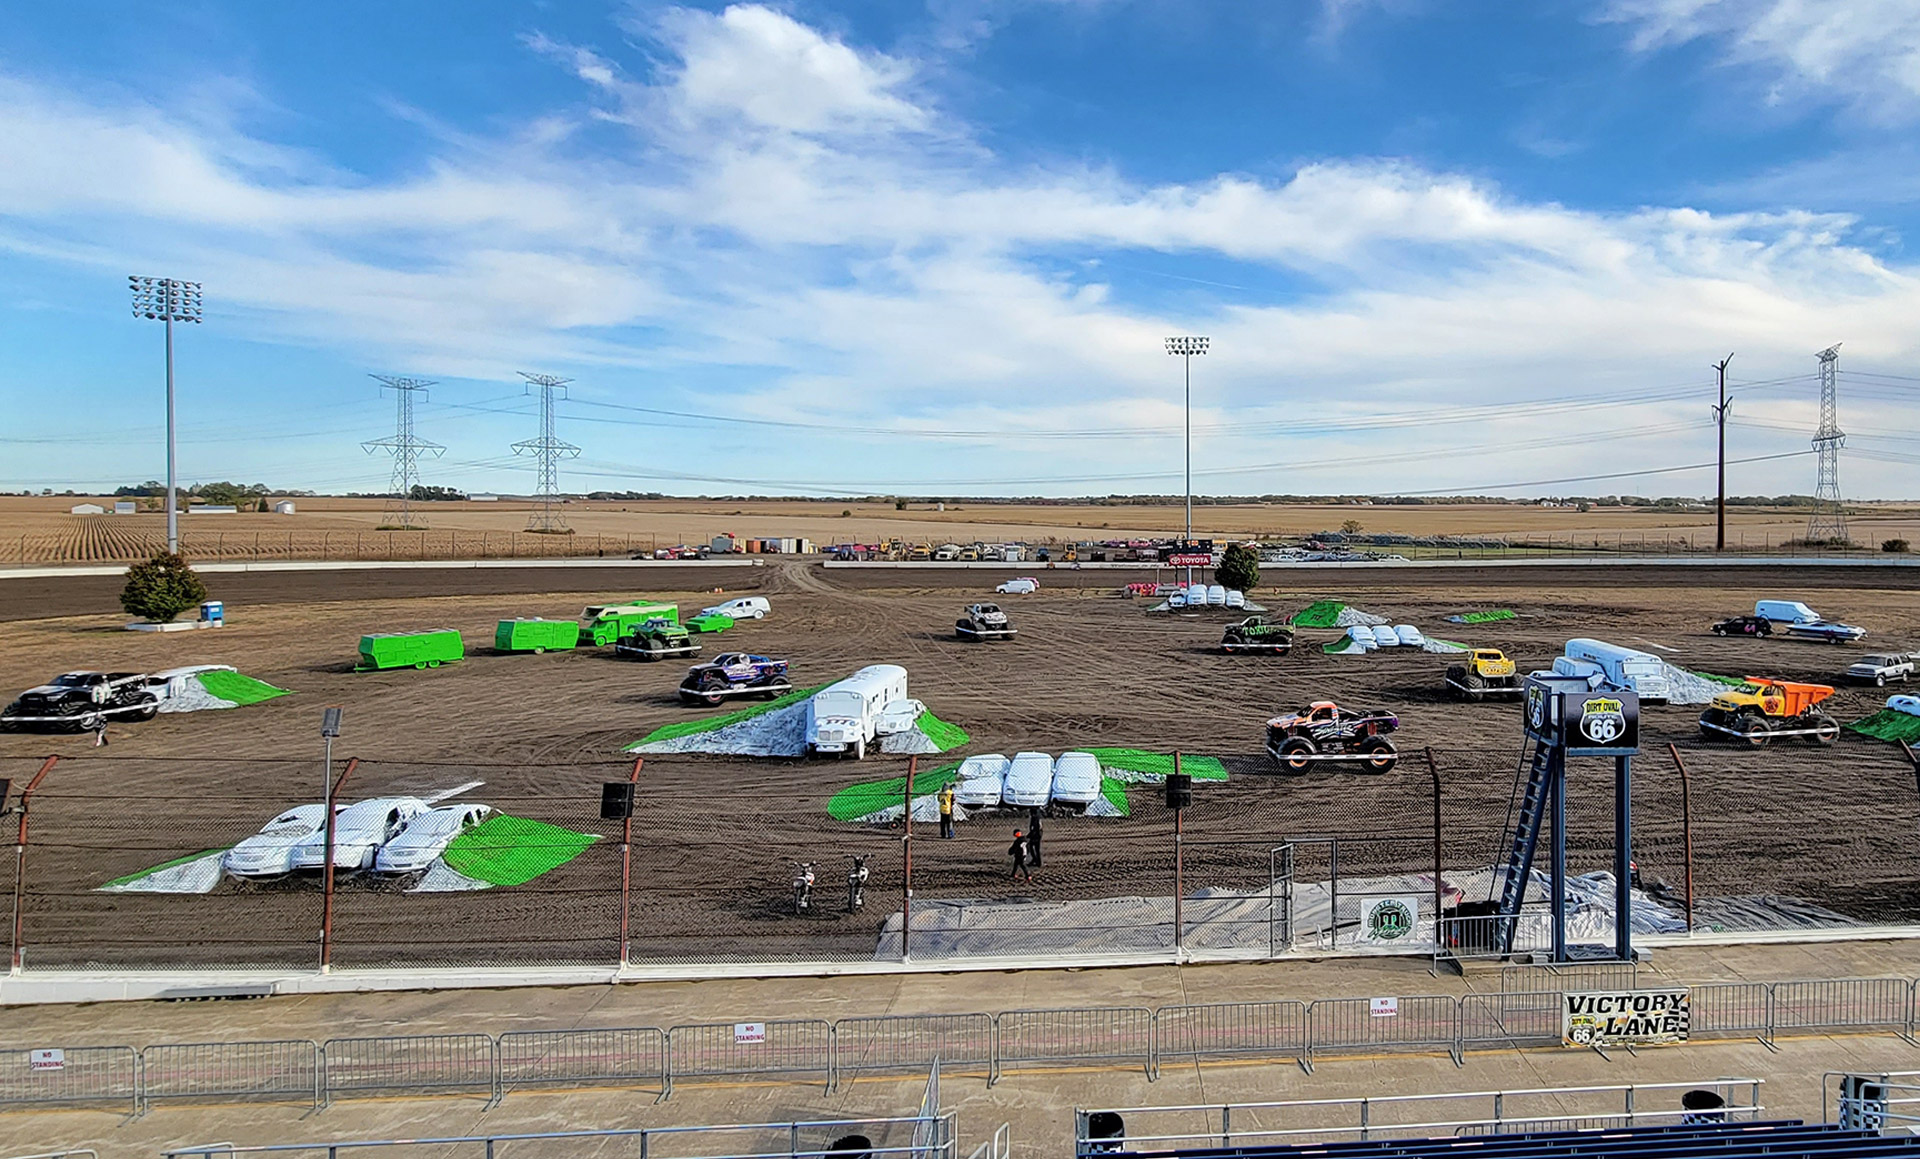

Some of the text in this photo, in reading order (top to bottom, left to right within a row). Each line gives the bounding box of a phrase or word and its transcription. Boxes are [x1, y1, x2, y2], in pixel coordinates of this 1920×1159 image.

[1181, 556, 1209, 564] TOYOTA
[1586, 702, 1620, 713] DIRT OVAL
[1590, 719, 1616, 739] 66
[1567, 994, 1687, 1013] VICTORY
[1604, 1016, 1679, 1035] LANE
[735, 1034, 765, 1042] STANDING
[1573, 1028, 1591, 1042] 66
[31, 1061, 65, 1070] STANDING
